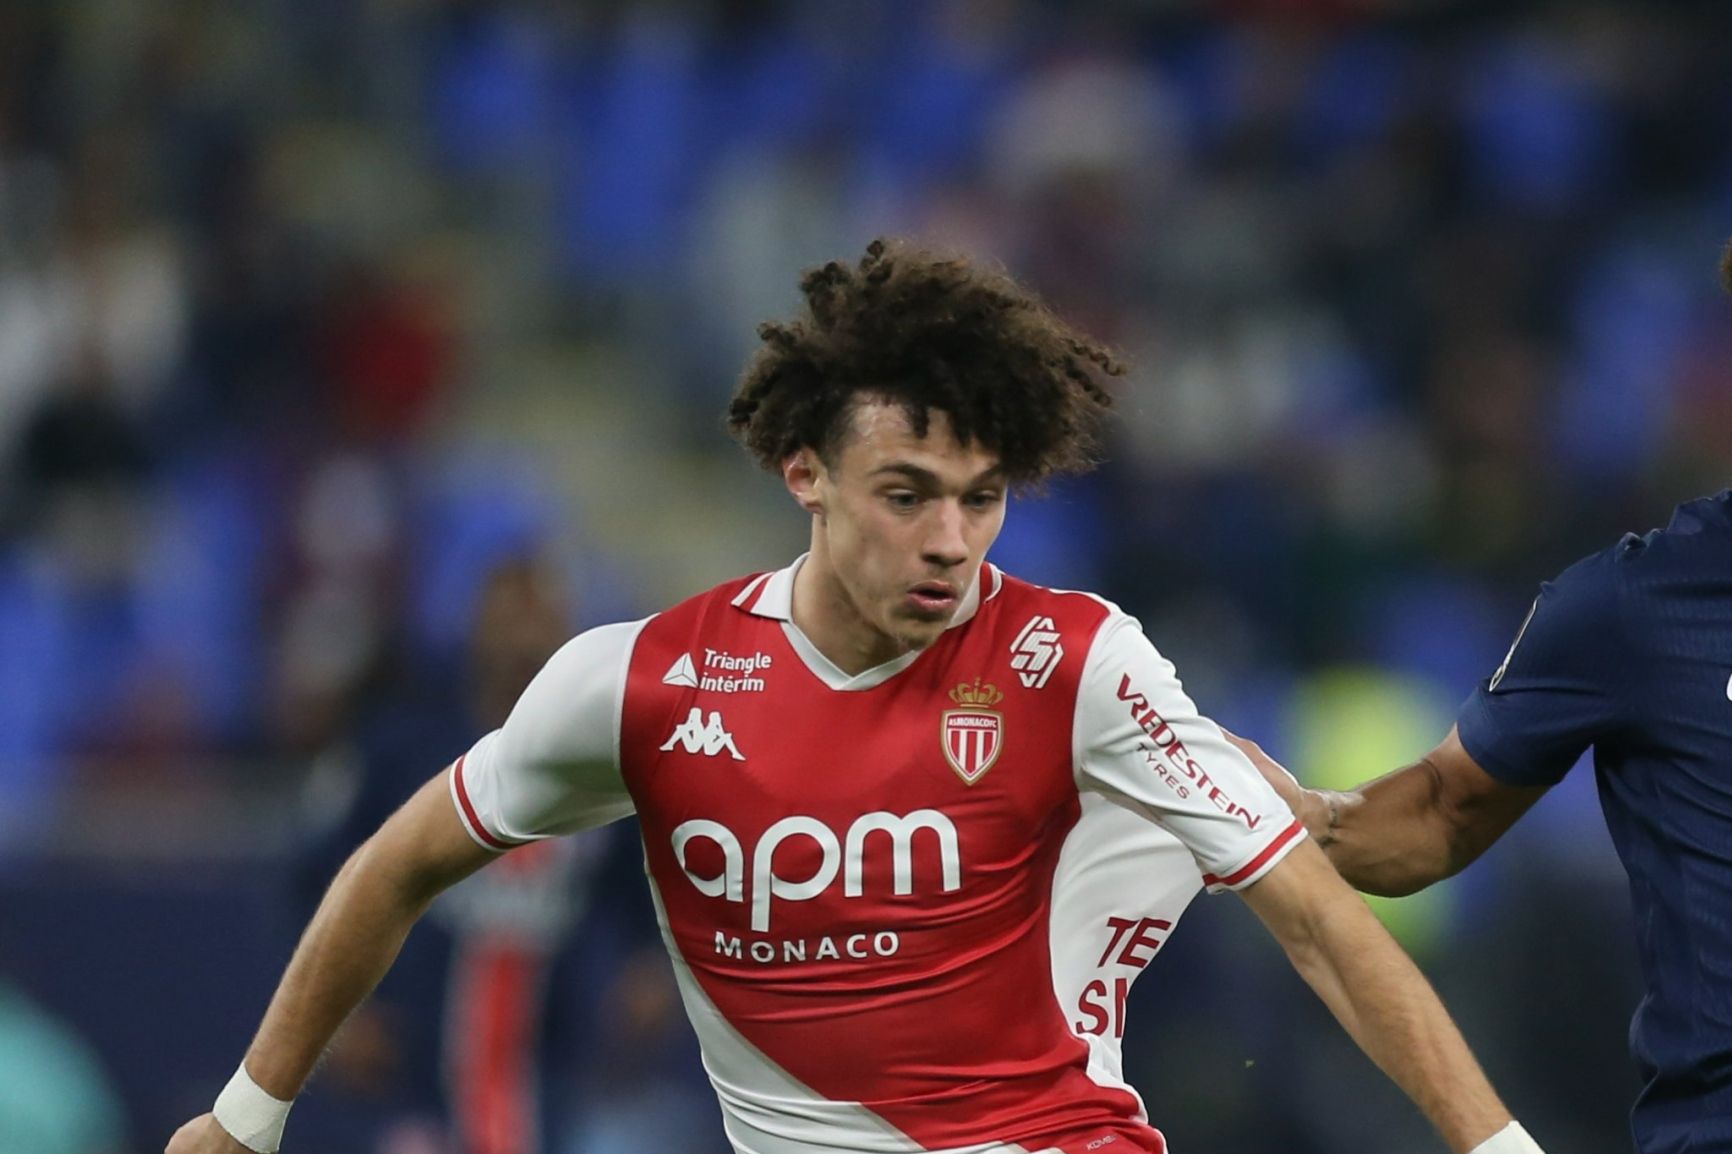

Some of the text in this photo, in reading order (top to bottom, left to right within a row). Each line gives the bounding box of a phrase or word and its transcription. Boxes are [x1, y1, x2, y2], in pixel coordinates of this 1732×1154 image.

[700, 672, 765, 693] intérim
[705, 648, 772, 674] Triangle
[1117, 672, 1261, 829] VREDESTEIN
[1136, 742, 1190, 799] TYRES
[671, 809, 961, 932] apm
[715, 931, 899, 963] MONACO
